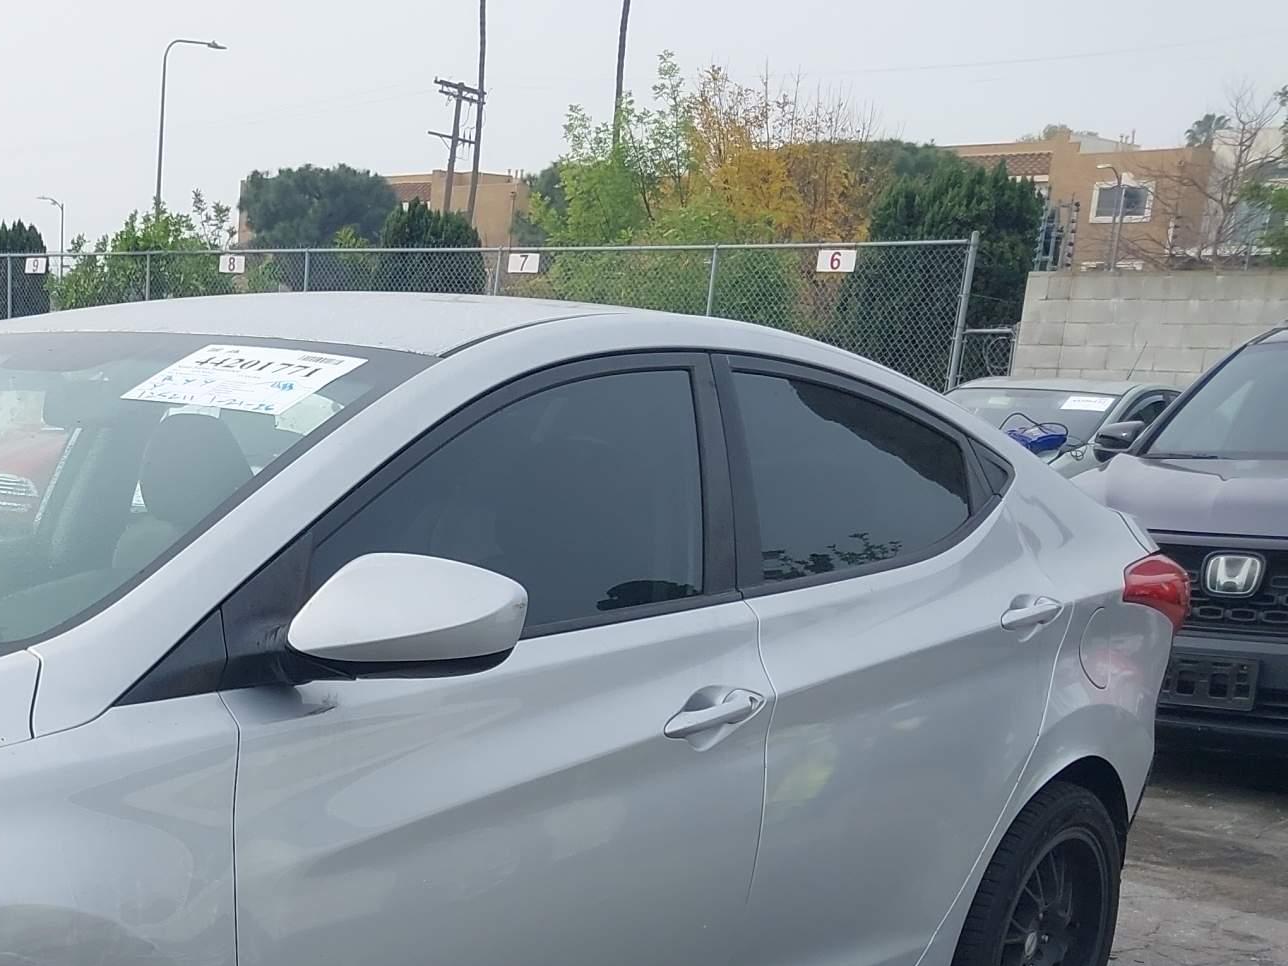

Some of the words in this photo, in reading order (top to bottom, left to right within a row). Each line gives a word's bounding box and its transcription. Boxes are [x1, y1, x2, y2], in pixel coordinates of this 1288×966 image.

[32, 258, 39, 272] 9
[228, 256, 236, 272] 8
[519, 254, 529, 271] 7
[830, 251, 842, 270] 6
[195, 356, 323, 378] 44201771
